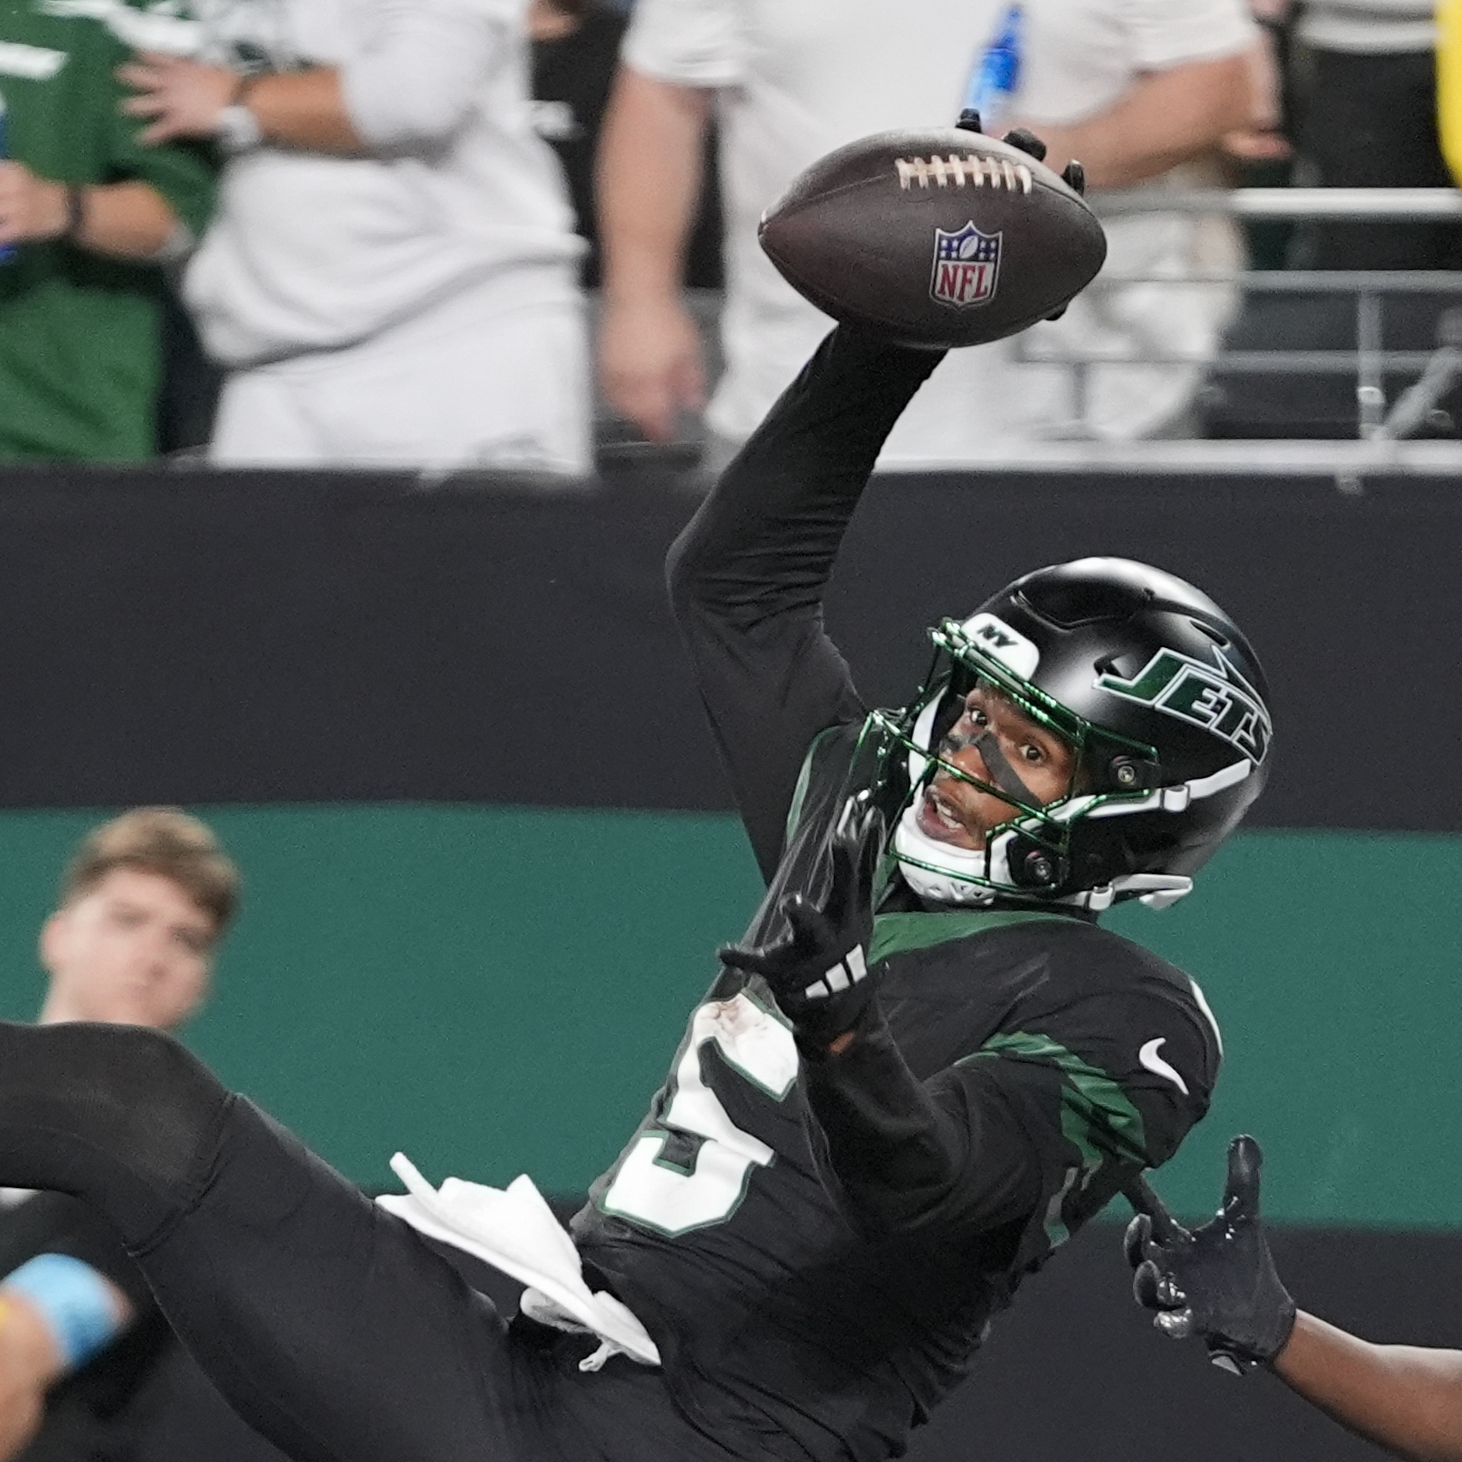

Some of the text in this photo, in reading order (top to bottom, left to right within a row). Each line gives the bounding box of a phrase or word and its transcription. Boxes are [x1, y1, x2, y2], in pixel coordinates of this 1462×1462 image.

[937, 263, 989, 302] NFL
[977, 622, 1018, 649] NY
[1092, 645, 1274, 766] JETS
[599, 988, 800, 1239] 5
